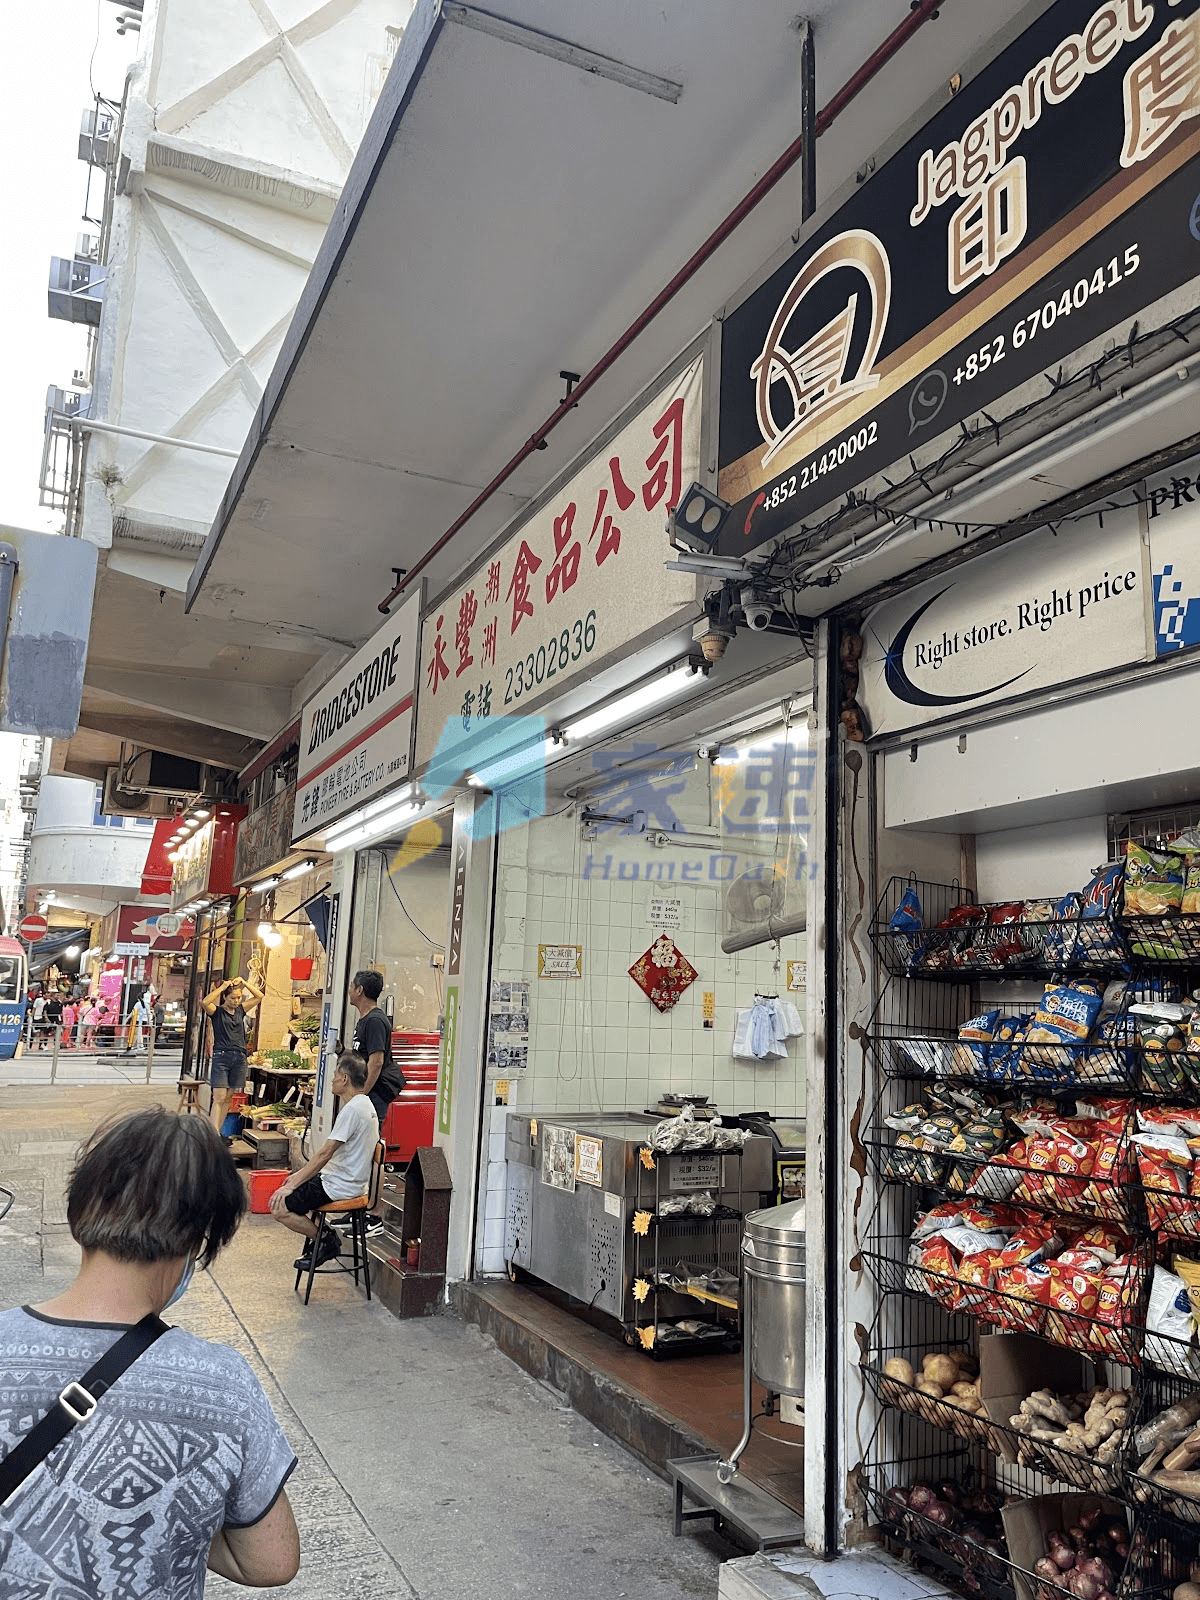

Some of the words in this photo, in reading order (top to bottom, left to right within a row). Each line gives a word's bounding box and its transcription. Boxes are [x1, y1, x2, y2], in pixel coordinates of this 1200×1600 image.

[953, 341, 1005, 386] +852
[1013, 243, 1140, 359] 67040415
[763, 476, 797, 511] +852
[801, 421, 878, 489] 21420002
[1148, 475, 1200, 520] PR
[914, 631, 959, 670] Right
[963, 619, 1012, 650] store.
[1017, 588, 1073, 632] Right
[1078, 570, 1137, 618] price
[308, 635, 402, 756] BRIDGESTONE
[461, 680, 493, 732] 電話
[504, 609, 597, 705] 23302836
[0, 1014, 21, 1026] 126
